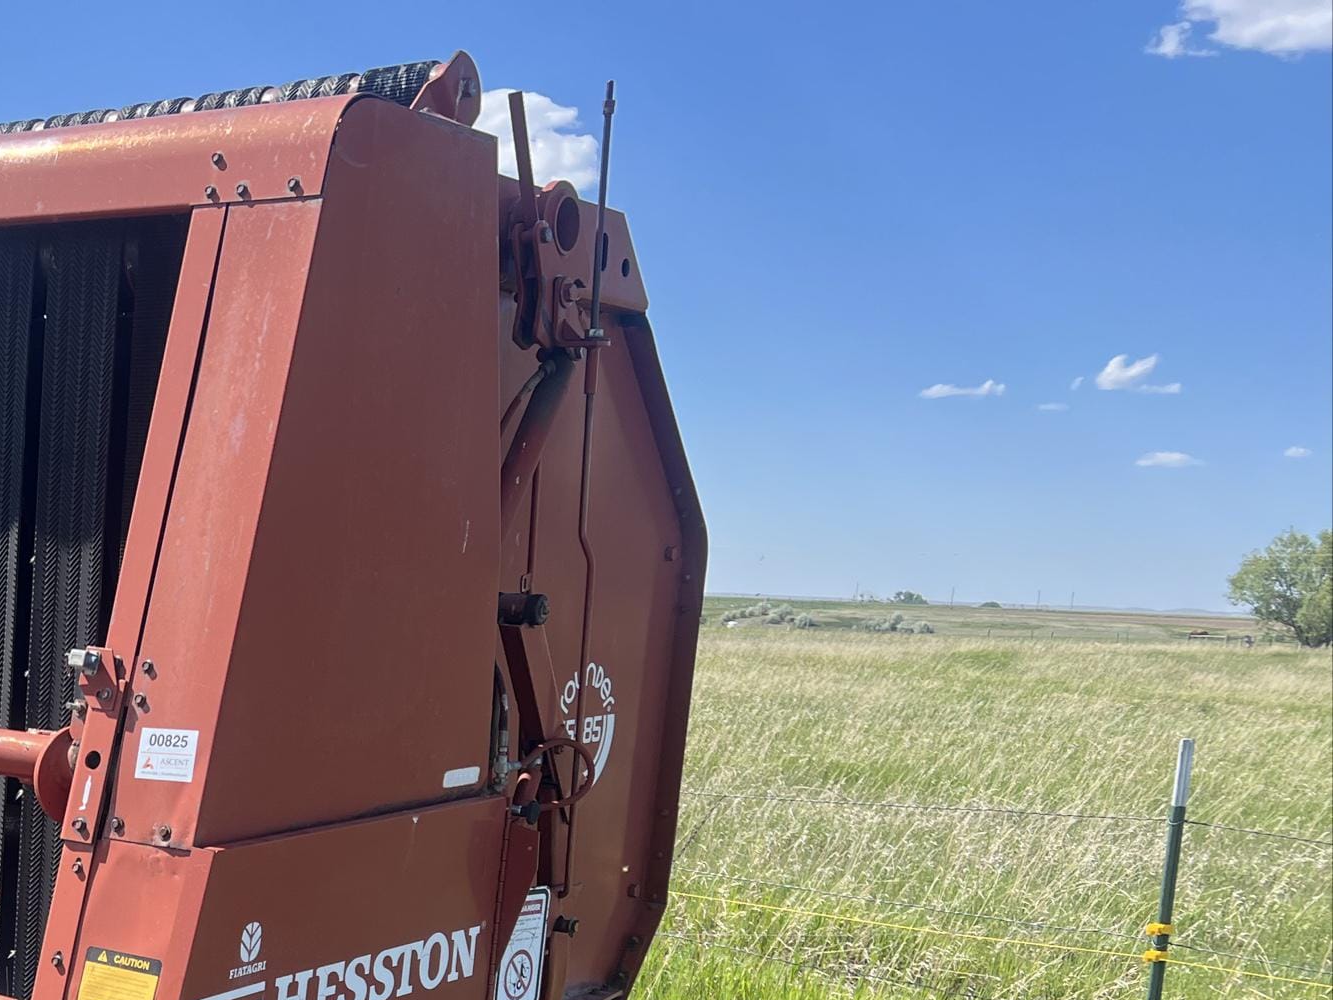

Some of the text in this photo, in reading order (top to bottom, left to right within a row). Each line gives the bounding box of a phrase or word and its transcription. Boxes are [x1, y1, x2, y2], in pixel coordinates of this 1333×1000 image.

[149, 733, 189, 748] 00825
[113, 954, 150, 971] CAUTION
[228, 960, 266, 980] FIATAGRI
